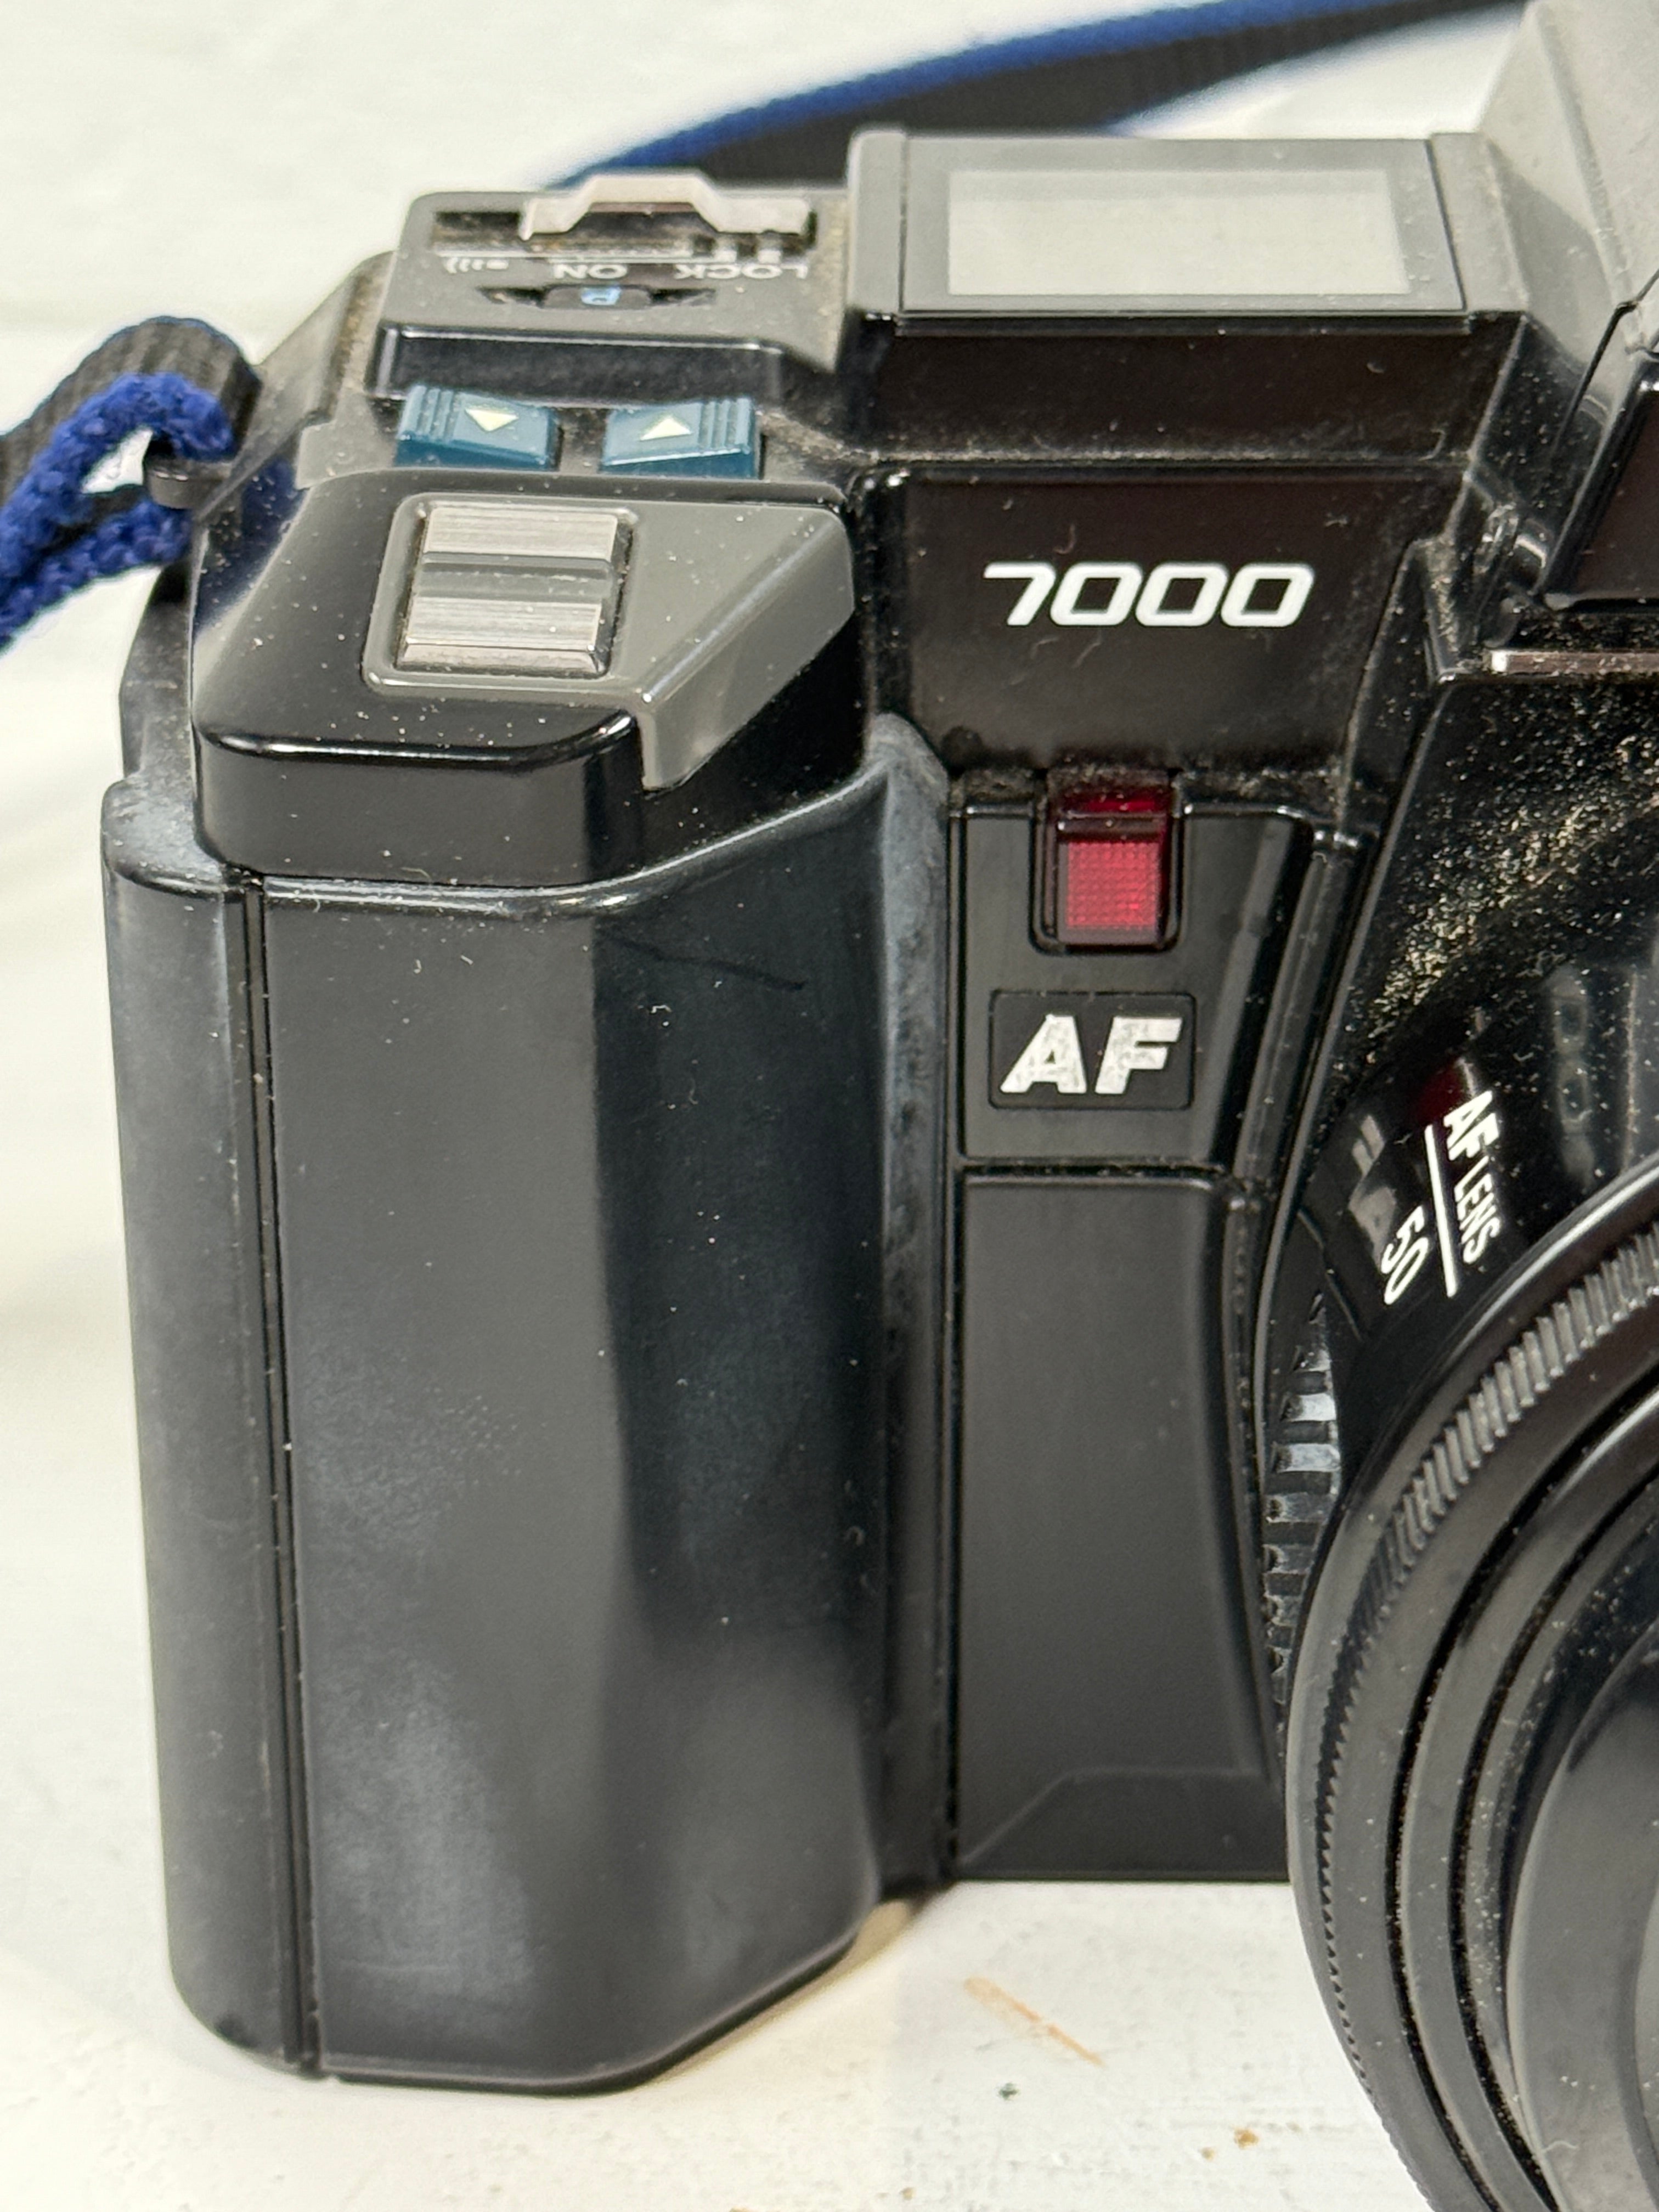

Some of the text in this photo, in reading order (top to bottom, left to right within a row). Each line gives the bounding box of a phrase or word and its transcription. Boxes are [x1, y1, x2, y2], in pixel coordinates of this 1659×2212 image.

[553, 263, 809, 280] LOCK ON
[984, 562, 1314, 627] 7000
[1000, 1013, 1182, 1094] AF
[1443, 1088, 1502, 1264] AF LENS
[1380, 1205, 1430, 1305] 50
